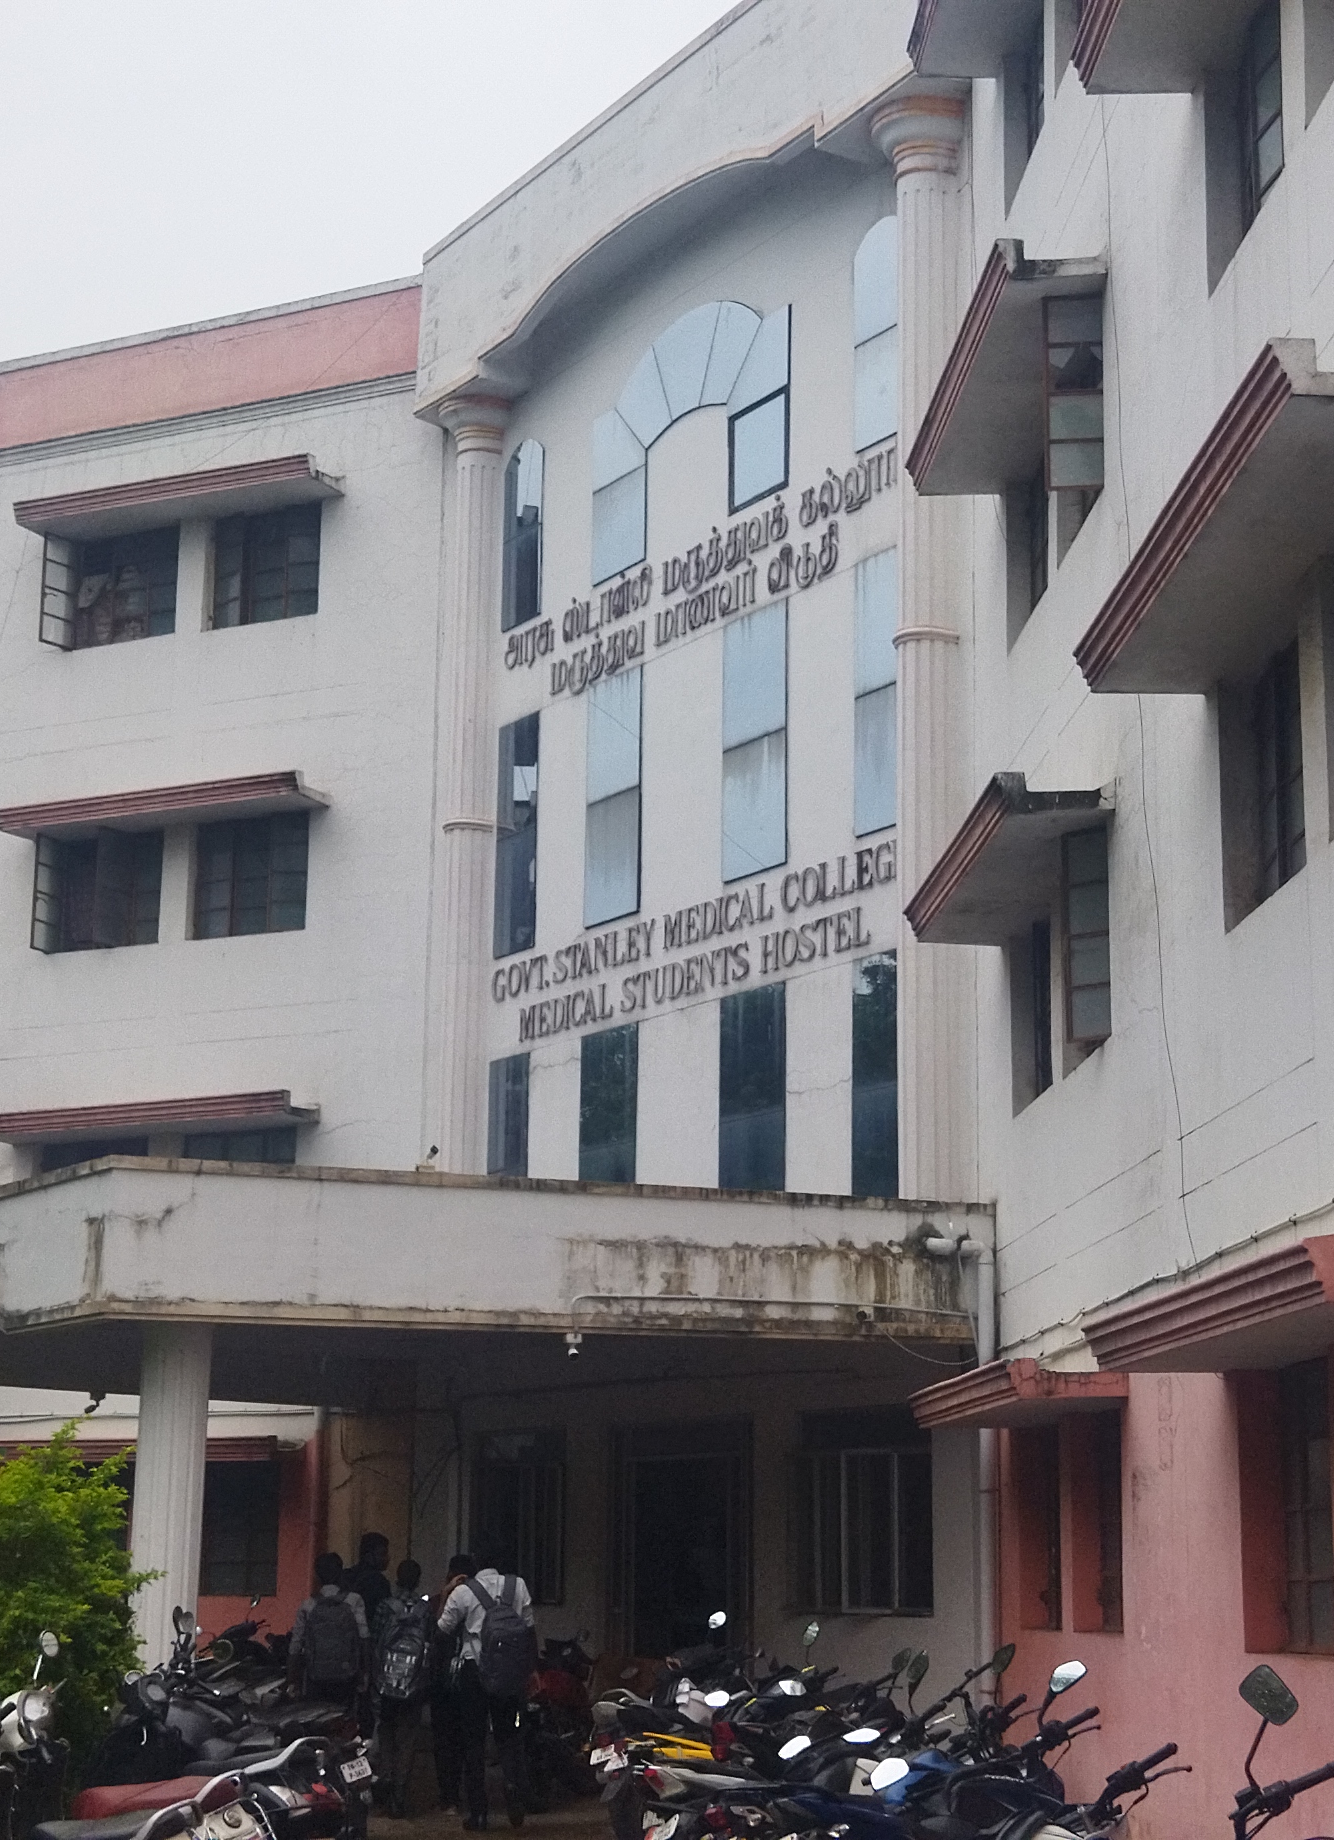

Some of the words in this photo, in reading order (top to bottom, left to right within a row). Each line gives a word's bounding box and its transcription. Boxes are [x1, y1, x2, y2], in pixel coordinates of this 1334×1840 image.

[504, 617, 554, 671] அரசு
[562, 563, 653, 643] ஸ்டான்லி
[661, 493, 789, 596] மருத்துவக்
[549, 620, 646, 697] மருத்துவ
[653, 558, 757, 649] மாணவர்
[518, 982, 614, 1043] MEDICAL
[620, 940, 750, 1014] STUDENTS
[759, 905, 871, 975] HOSTEL
[662, 881, 775, 951] MEDICAL
